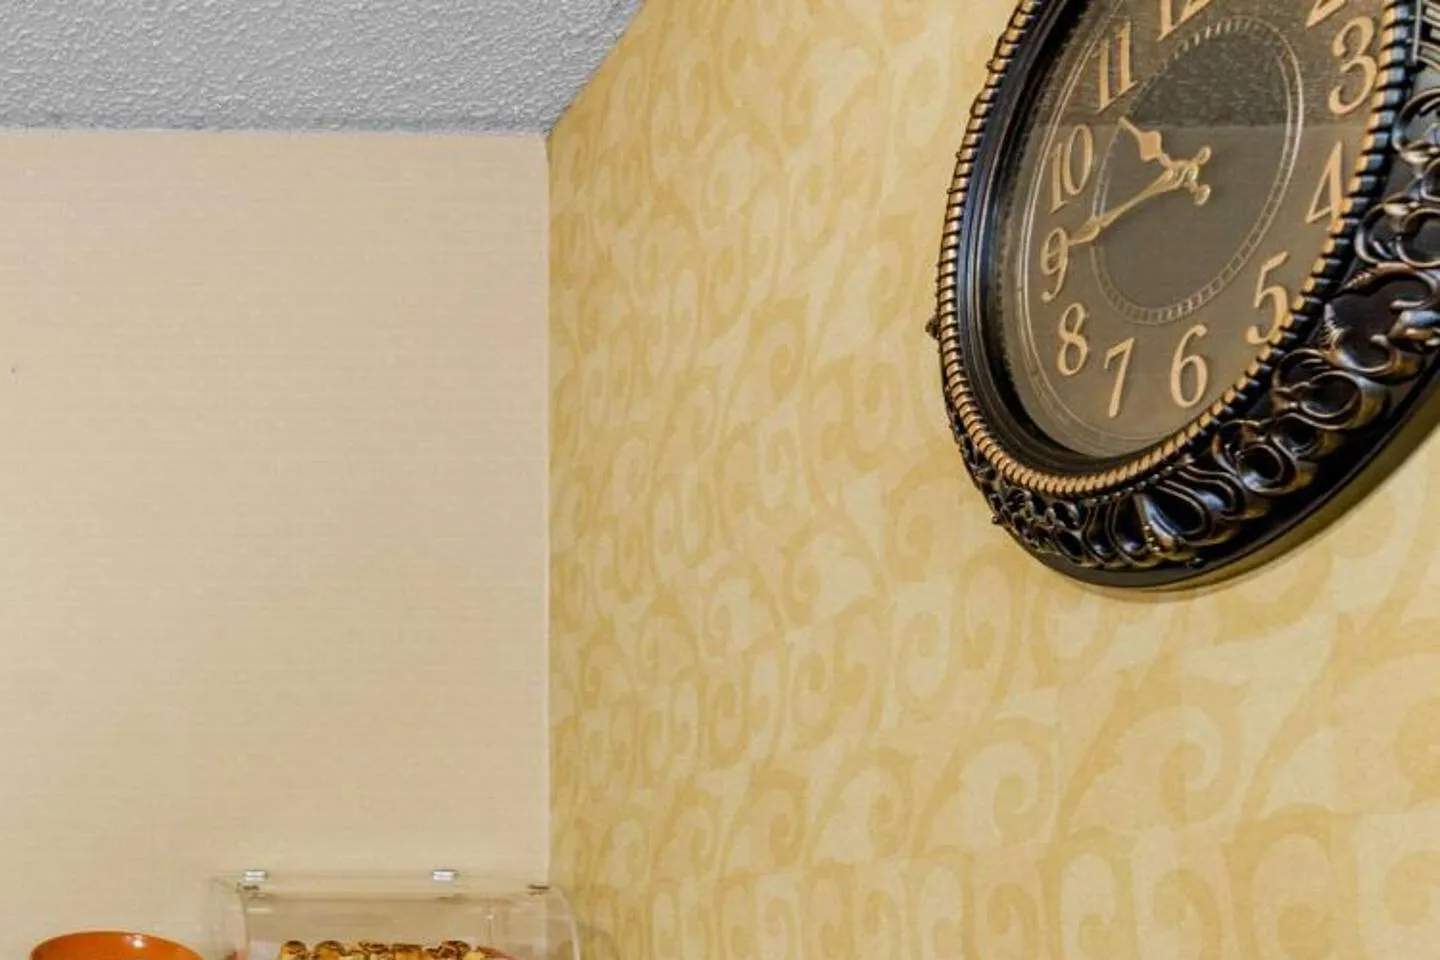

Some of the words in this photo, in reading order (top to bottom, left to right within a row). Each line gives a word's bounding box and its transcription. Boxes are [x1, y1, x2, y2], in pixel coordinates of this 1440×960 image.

[1096, 18, 1137, 114] 11
[1329, 17, 1378, 115] 3
[1047, 124, 1093, 213] 10
[1306, 141, 1348, 226] 4
[1040, 227, 1069, 302] 9
[1246, 251, 1288, 344] 5
[1058, 303, 1089, 376] 8
[1103, 337, 1136, 417] 7
[1170, 325, 1208, 408] 6
